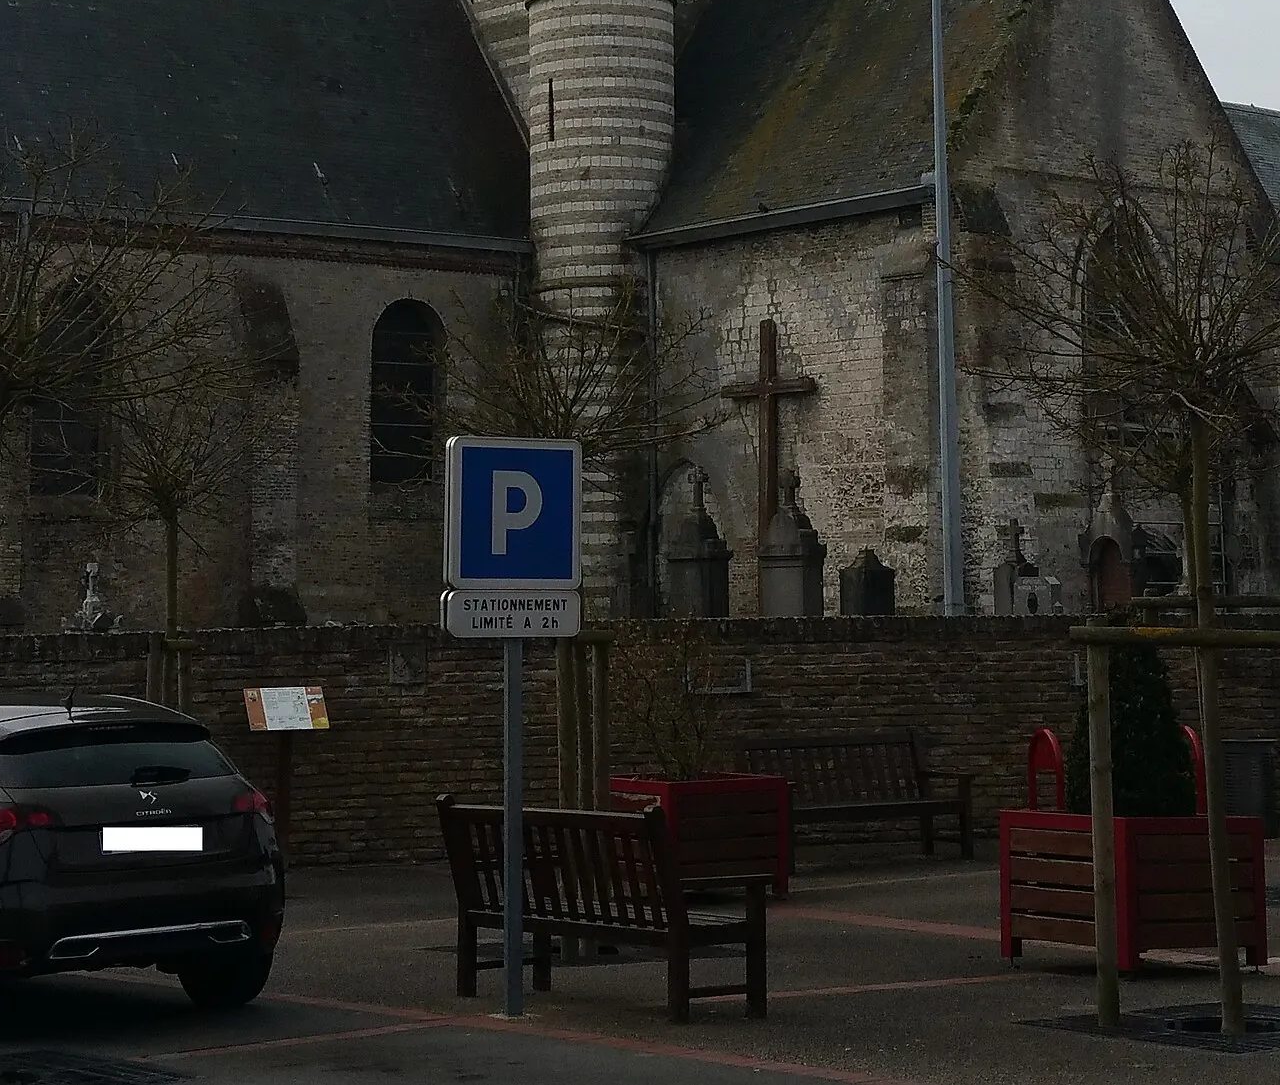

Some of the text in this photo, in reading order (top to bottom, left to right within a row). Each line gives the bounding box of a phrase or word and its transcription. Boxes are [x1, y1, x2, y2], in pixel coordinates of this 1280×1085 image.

[492, 470, 543, 555] P
[463, 599, 568, 611] STATIONNEMENT
[472, 614, 559, 629] LIMITÉ A 2h
